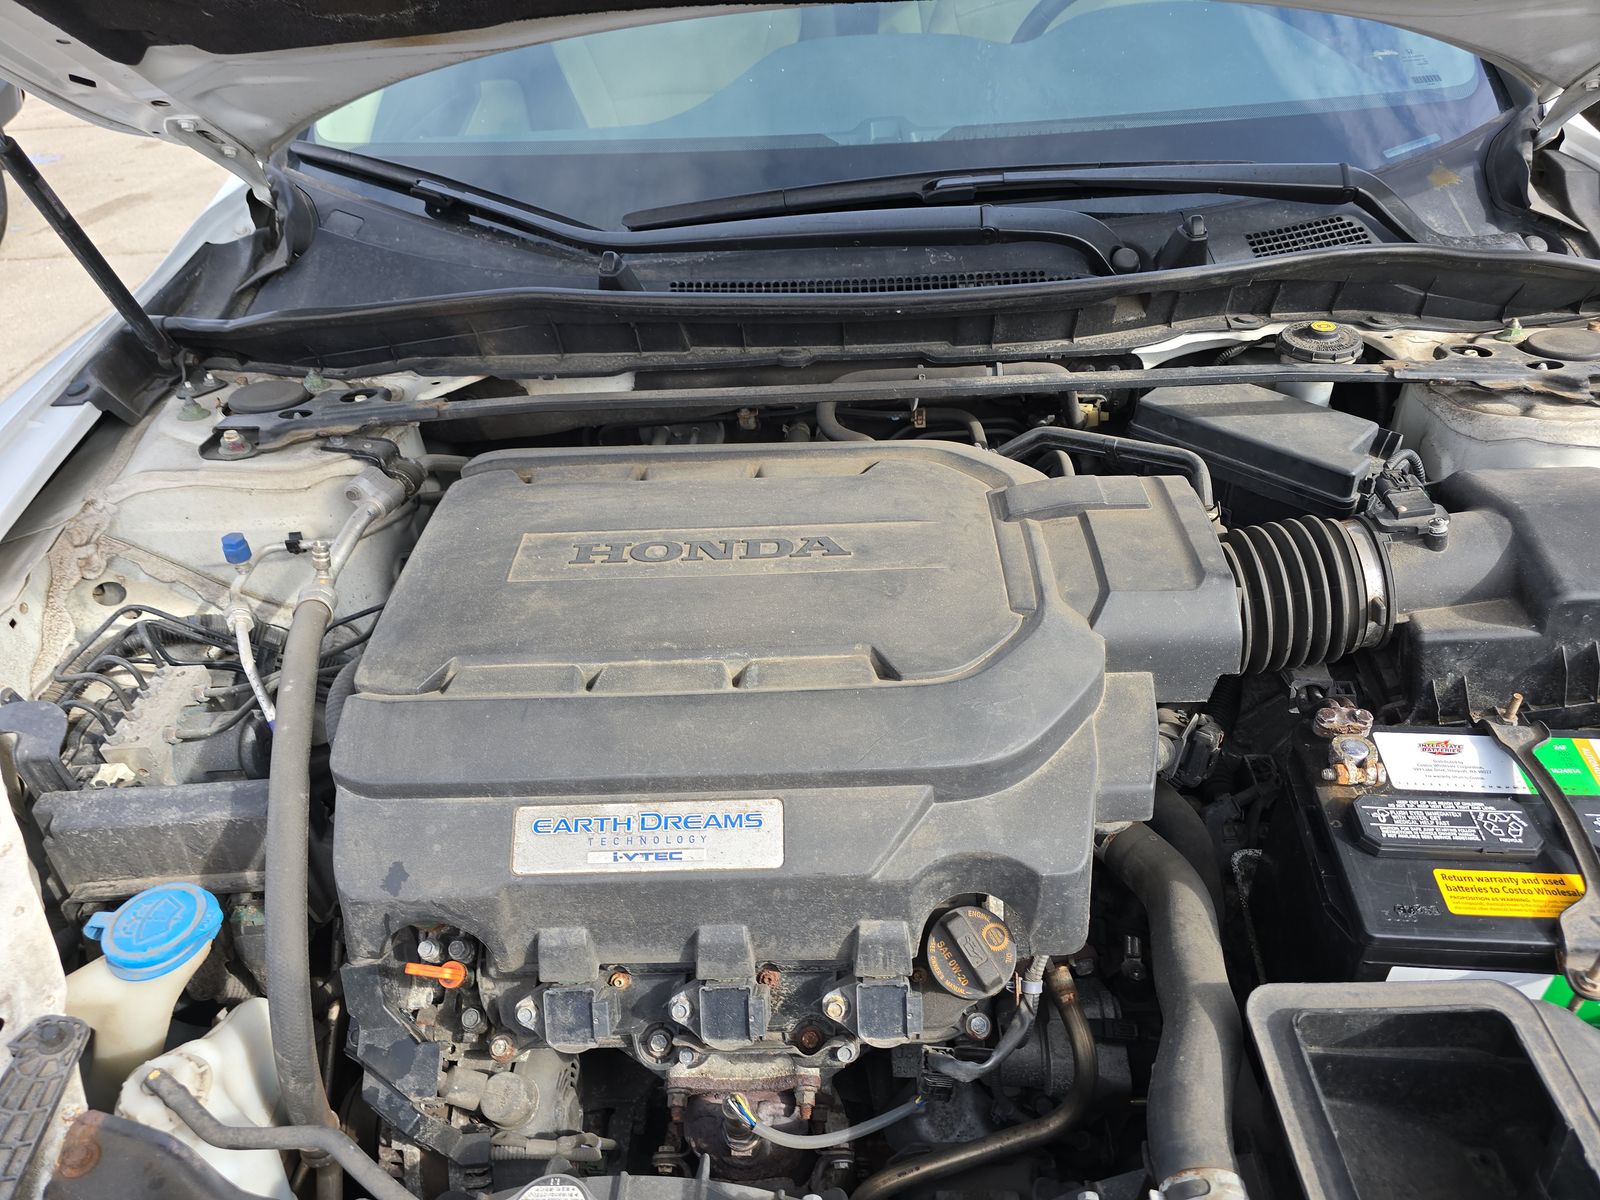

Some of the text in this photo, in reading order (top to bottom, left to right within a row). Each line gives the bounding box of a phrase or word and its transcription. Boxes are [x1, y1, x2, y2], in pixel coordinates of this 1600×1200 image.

[568, 534, 853, 566] HONDA
[532, 811, 764, 836] EARTH DREAMS
[588, 835, 707, 847] TECHNOLOGY
[1440, 873, 1566, 886] Return warranty and used
[1445, 884, 1489, 894] batteries
[1489, 886, 1500, 894] to
[1502, 886, 1534, 895] Costco
[937, 941, 953, 958] SAE
